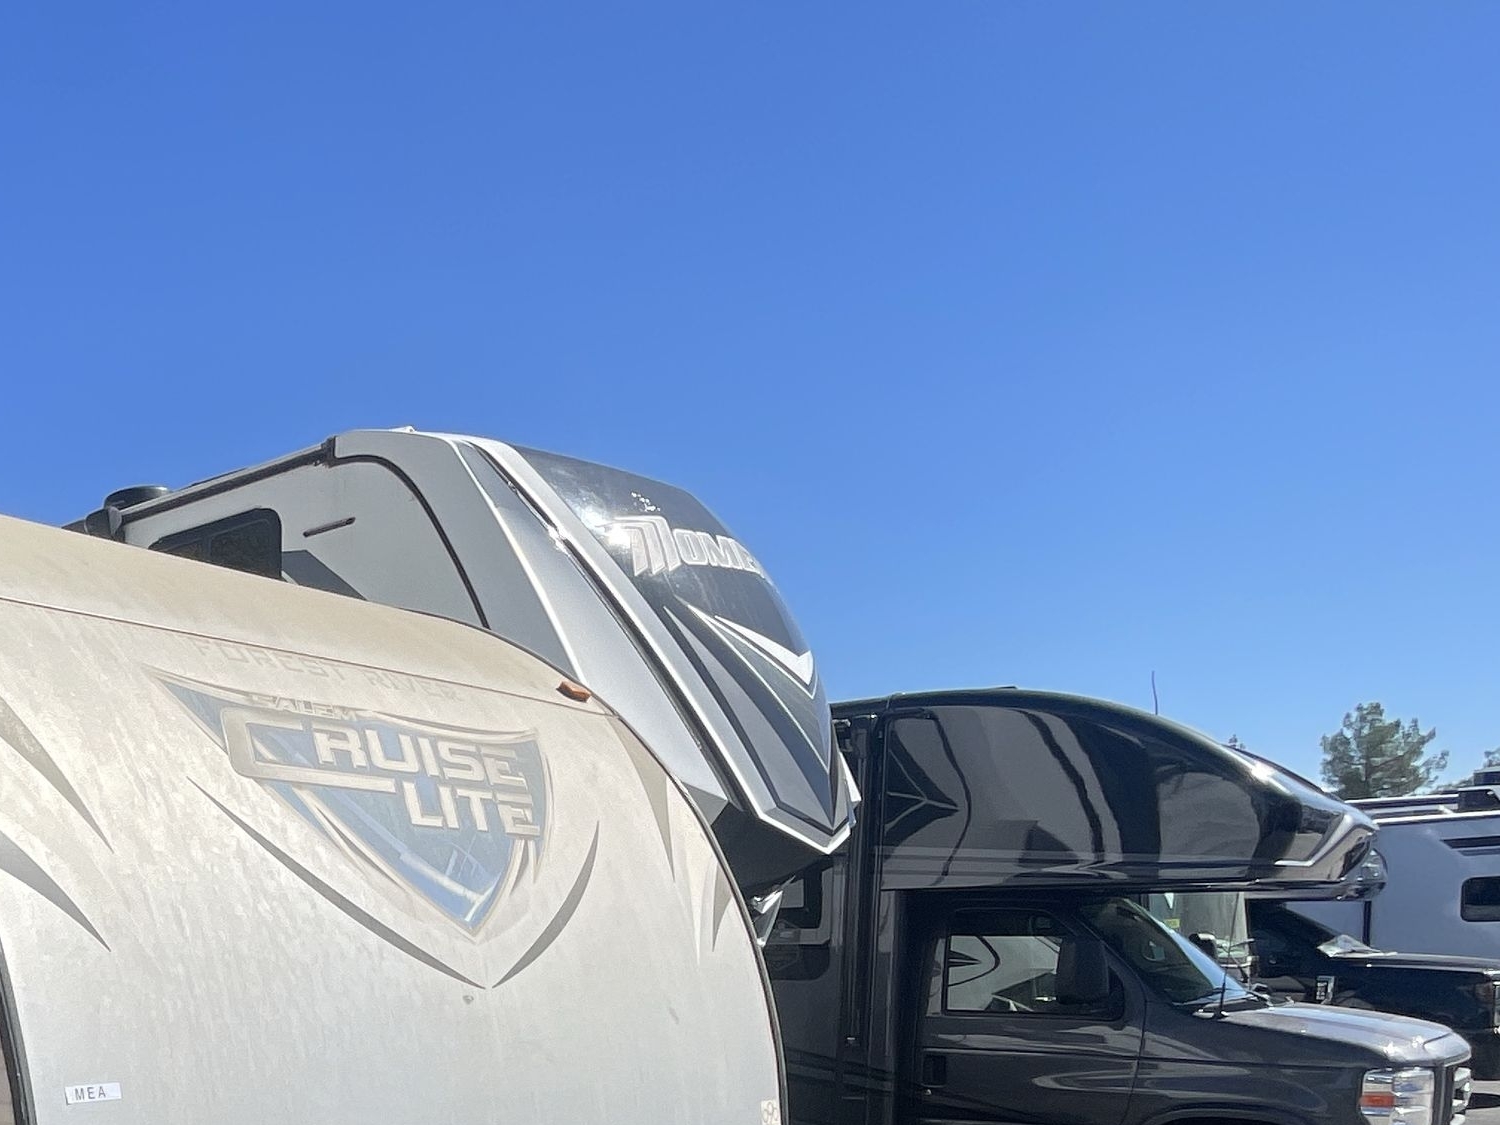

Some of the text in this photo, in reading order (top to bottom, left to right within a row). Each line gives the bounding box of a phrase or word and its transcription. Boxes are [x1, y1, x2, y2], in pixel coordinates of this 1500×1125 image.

[190, 638, 463, 702] FOREST RIVER
[219, 706, 531, 794] CRUISE
[399, 778, 542, 839] LITE
